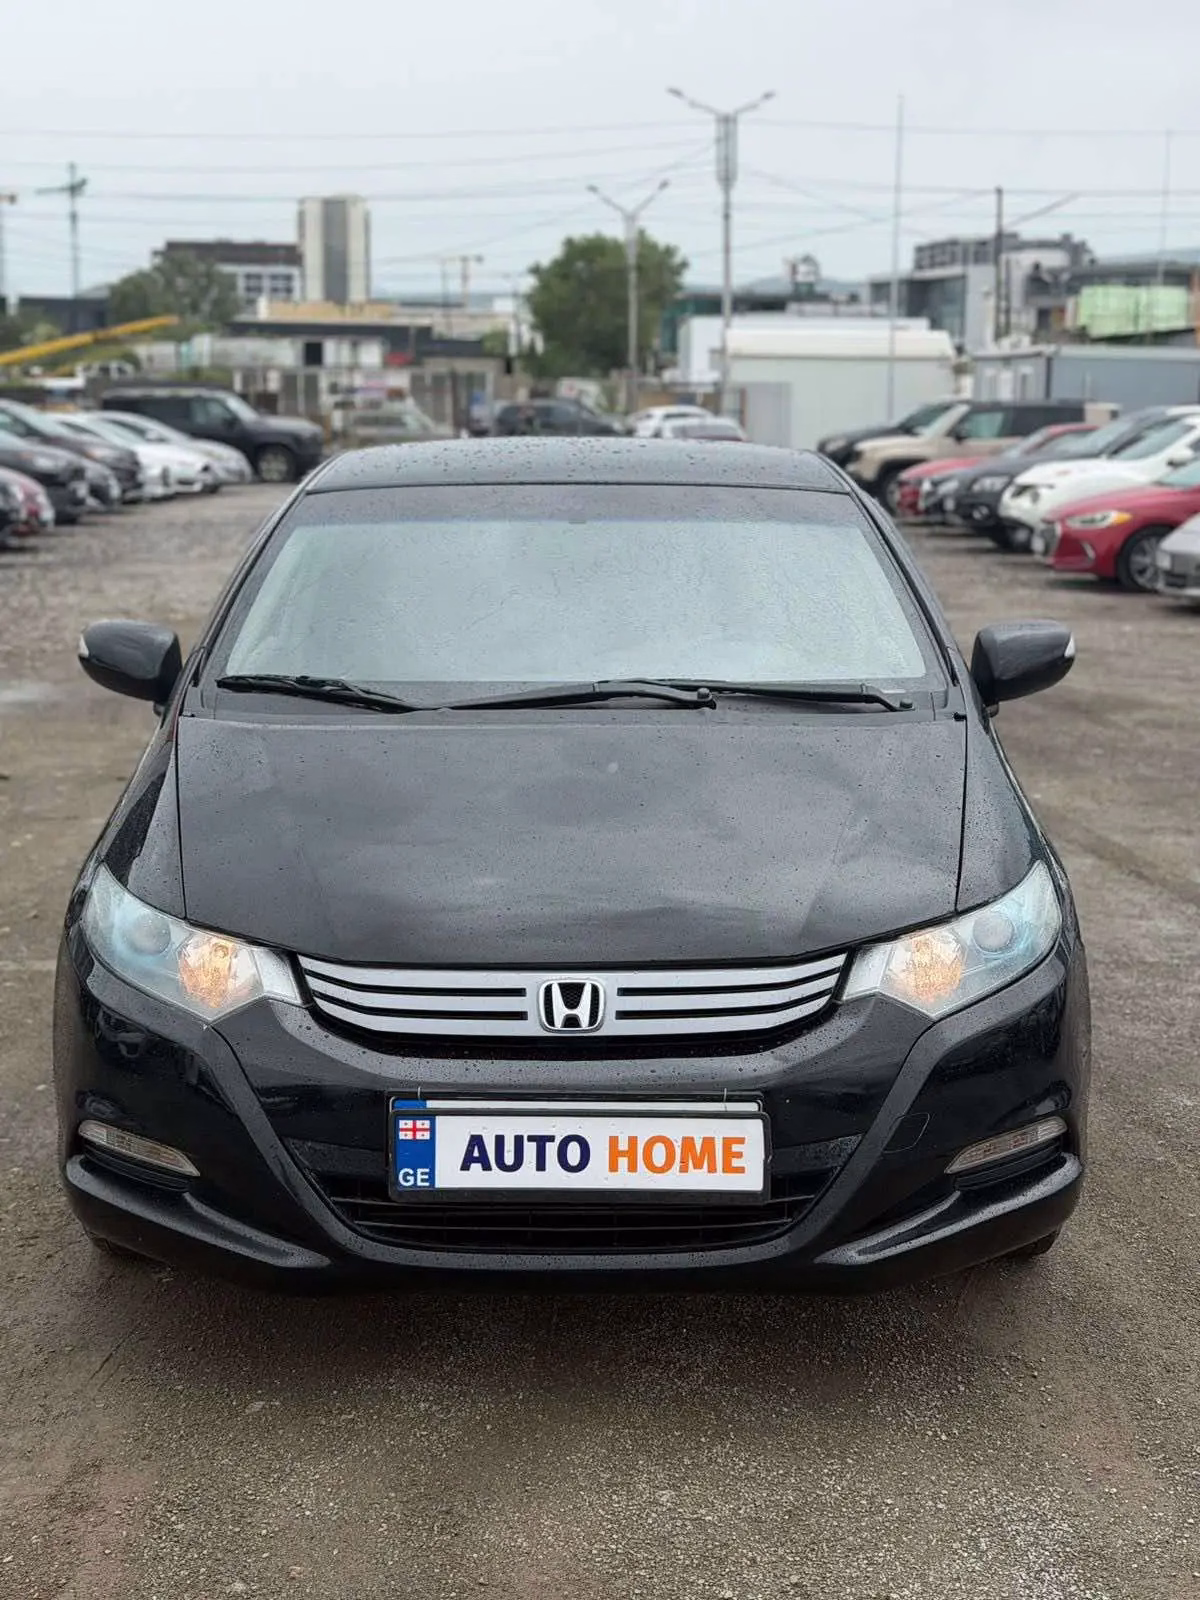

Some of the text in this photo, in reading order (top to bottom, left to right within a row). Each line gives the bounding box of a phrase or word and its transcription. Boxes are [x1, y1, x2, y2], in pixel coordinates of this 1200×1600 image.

[460, 1134, 746, 1174] AUTO HOME
[399, 1168, 430, 1186] GE
